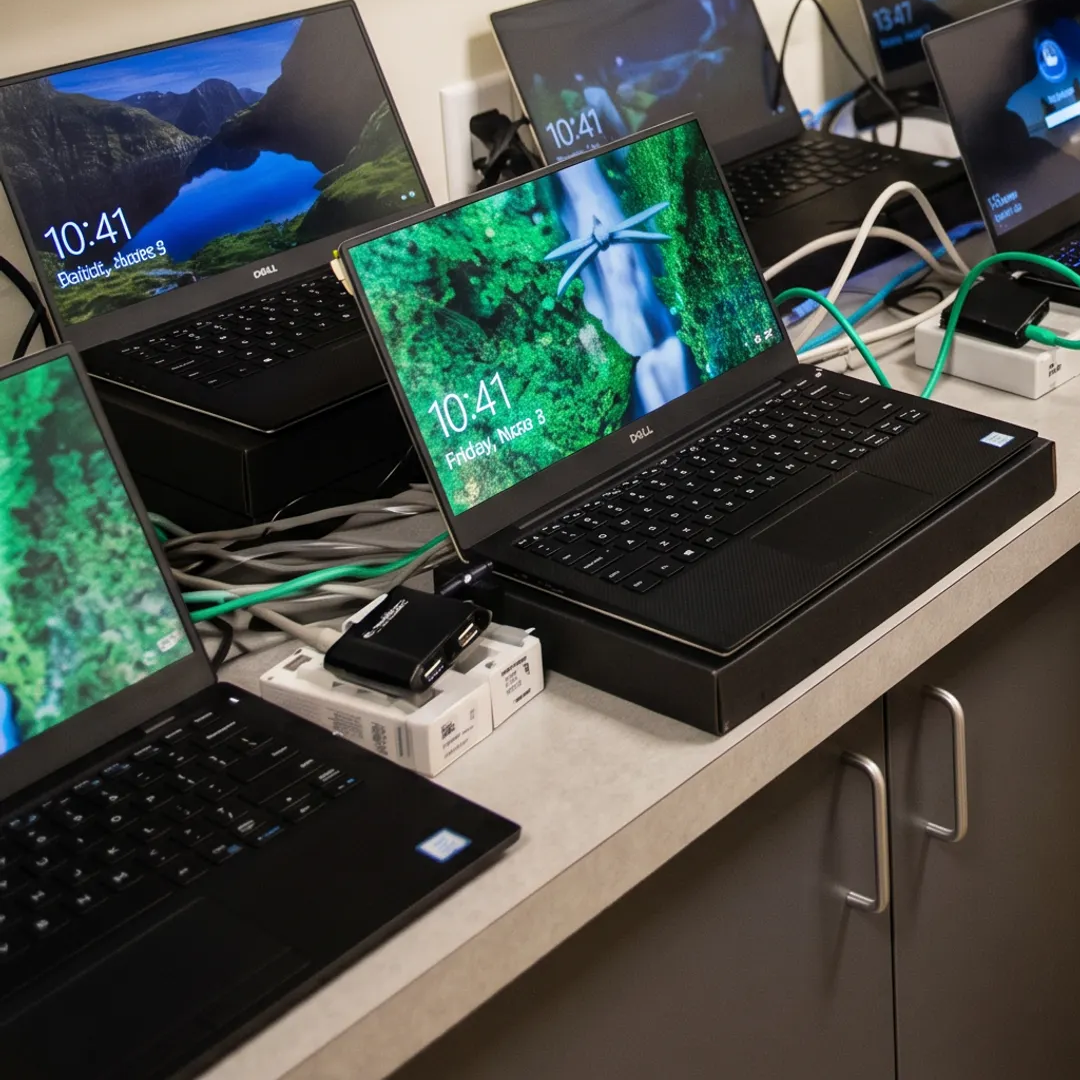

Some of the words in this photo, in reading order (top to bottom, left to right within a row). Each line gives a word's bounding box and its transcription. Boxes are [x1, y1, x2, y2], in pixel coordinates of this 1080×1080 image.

[545, 108, 603, 149] 10:41
[44, 206, 132, 260] 10:41
[427, 371, 512, 438] 10:41
